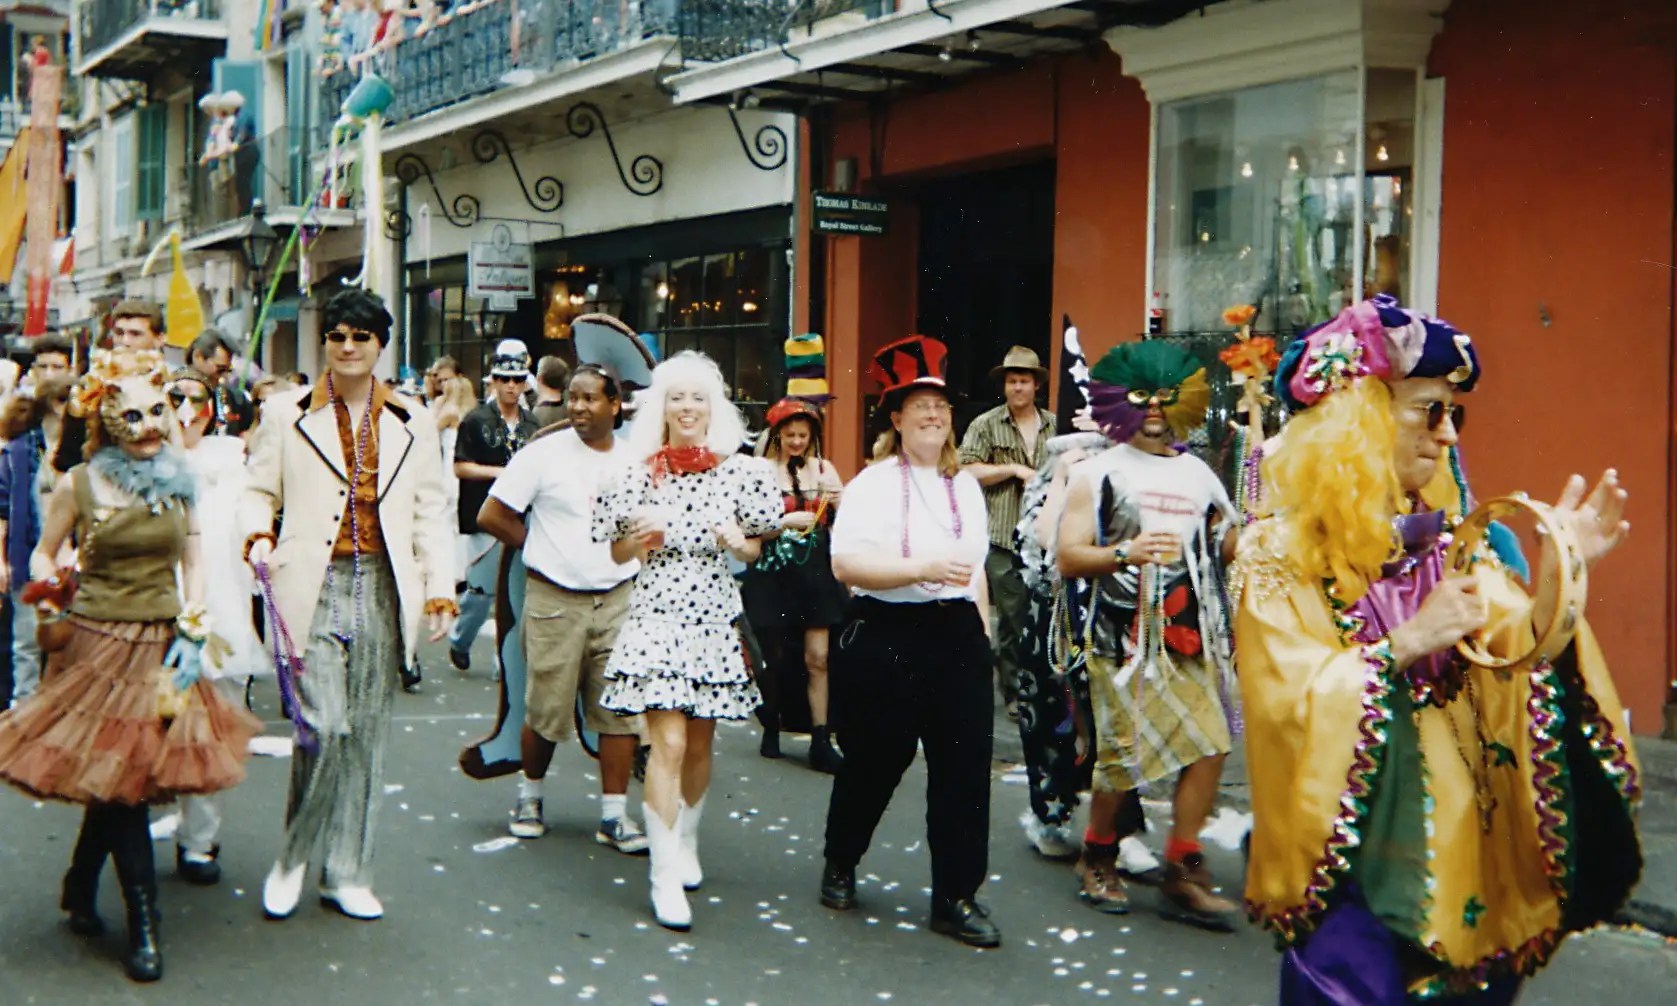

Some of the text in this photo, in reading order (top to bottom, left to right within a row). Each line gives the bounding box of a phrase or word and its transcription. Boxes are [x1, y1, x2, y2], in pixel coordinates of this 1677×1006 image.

[819, 220, 883, 234] Royal Street Gallery
